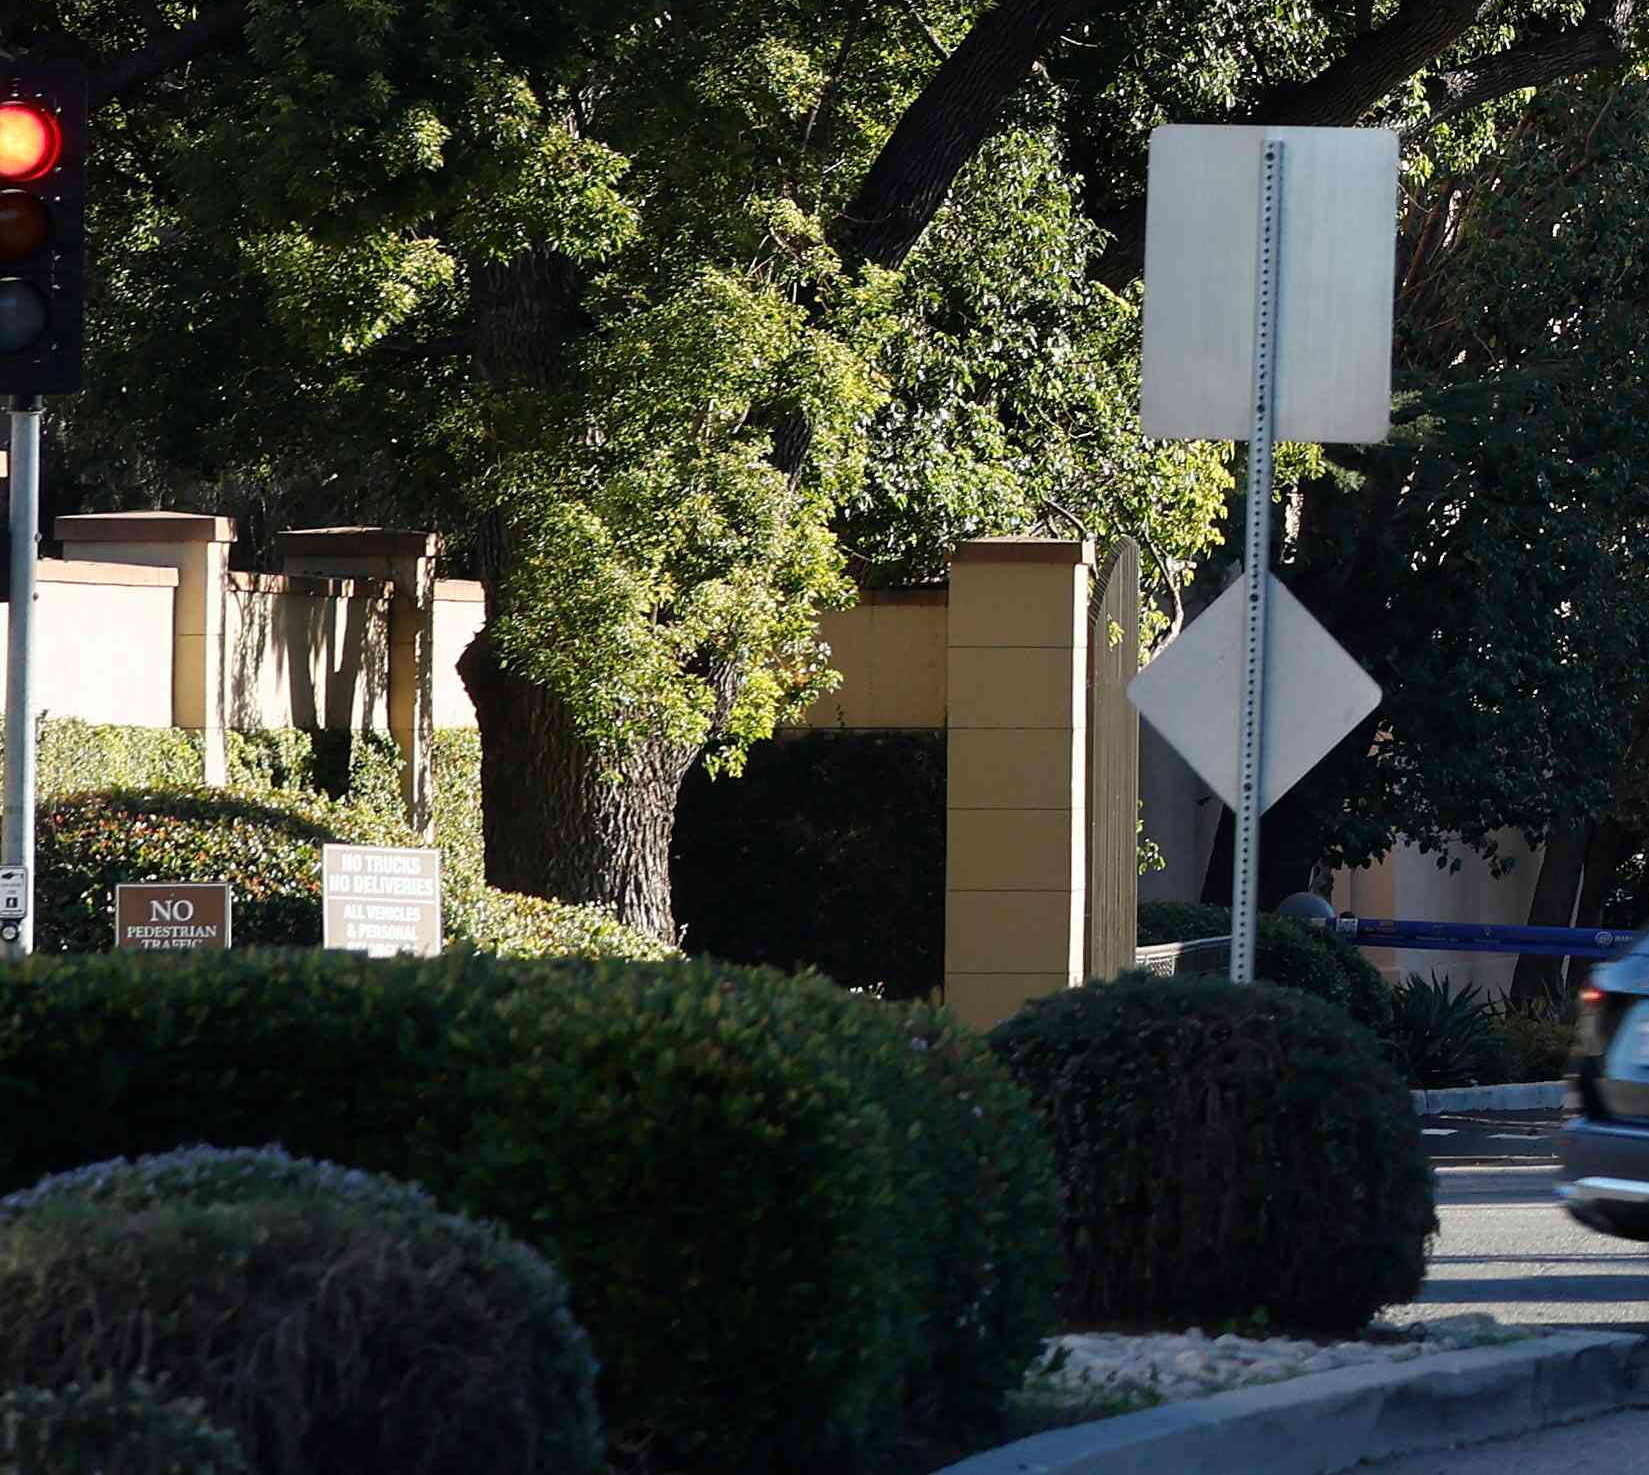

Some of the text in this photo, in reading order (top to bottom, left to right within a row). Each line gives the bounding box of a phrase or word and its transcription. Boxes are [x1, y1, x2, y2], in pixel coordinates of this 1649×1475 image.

[341, 853, 422, 875] NO TRUCKS
[328, 873, 434, 896] NO DELIVERIES
[149, 899, 194, 922] NO
[343, 904, 421, 923] ALL VEHICLES
[127, 925, 217, 938] PEDESTRIAN
